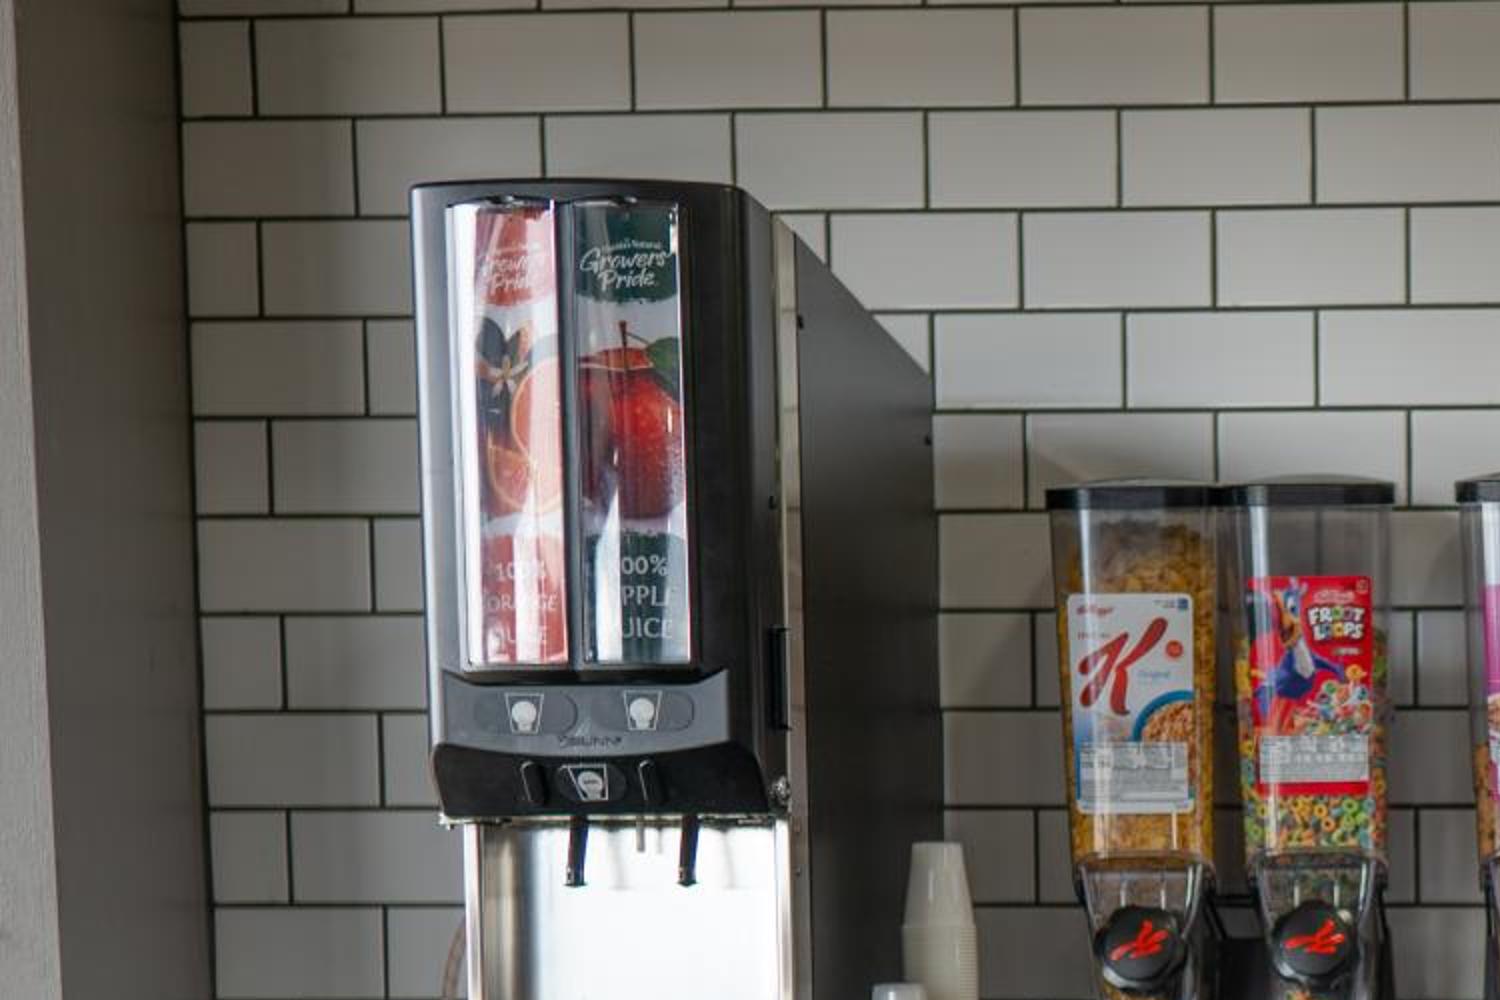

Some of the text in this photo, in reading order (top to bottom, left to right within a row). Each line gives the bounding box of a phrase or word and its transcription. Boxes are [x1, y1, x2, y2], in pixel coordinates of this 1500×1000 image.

[580, 247, 669, 272] Growers
[599, 263, 656, 291] Pride
[621, 554, 669, 576] 00%
[622, 617, 674, 639] UICE
